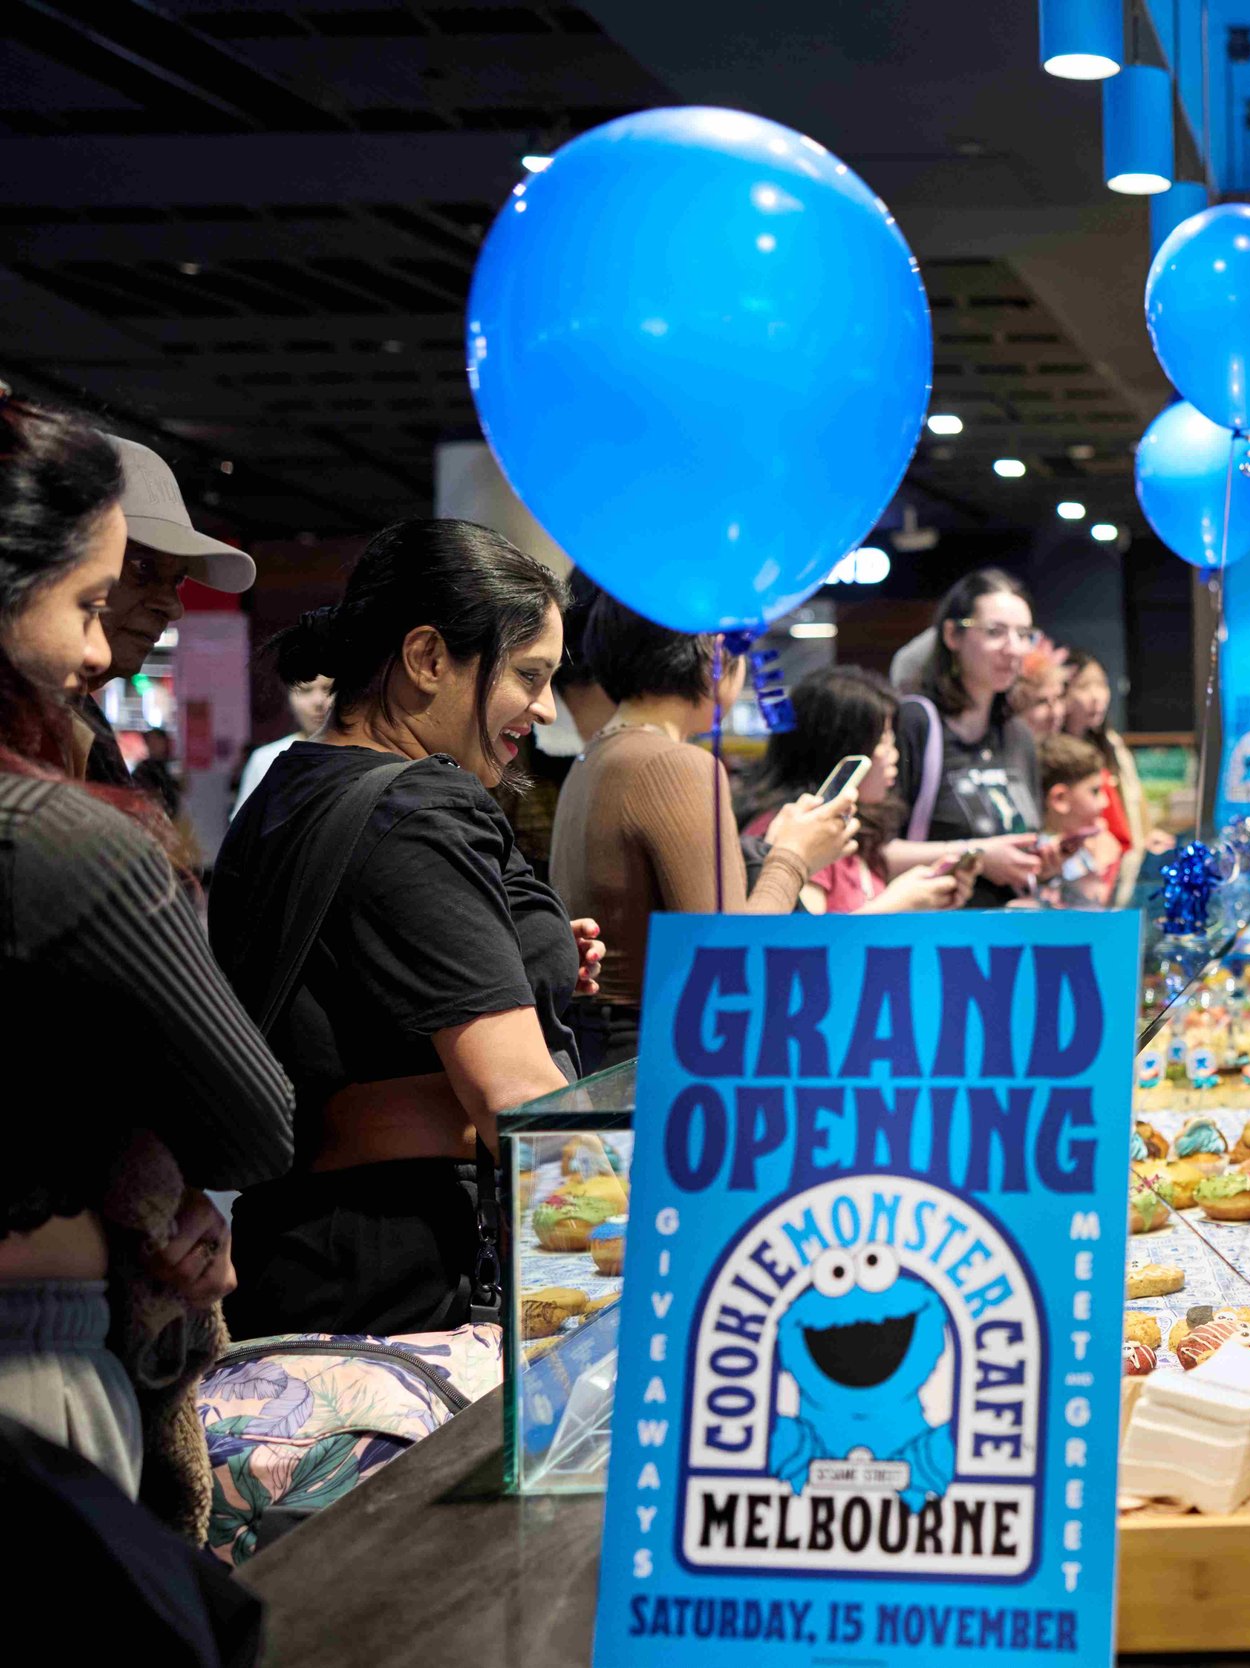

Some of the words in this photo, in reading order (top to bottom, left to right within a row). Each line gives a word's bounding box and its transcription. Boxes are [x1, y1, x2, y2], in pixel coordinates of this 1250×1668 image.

[674, 946, 1104, 1078] GRAND
[665, 1085, 1099, 1193] OPENING
[705, 1240, 797, 1454] COOKIE
[781, 1193, 1013, 1319] MONSTER
[972, 1320, 1025, 1459] CAFE
[1069, 1211, 1099, 1361] MEET
[633, 1207, 679, 1579] GIVEAWAYS
[698, 1493, 1019, 1557] MELBOURNE
[1062, 1399, 1091, 1592] GREET
[629, 1596, 815, 1646] SATURDAY,
[827, 1604, 863, 1643] 15
[877, 1605, 1078, 1653] NOVEMBER
